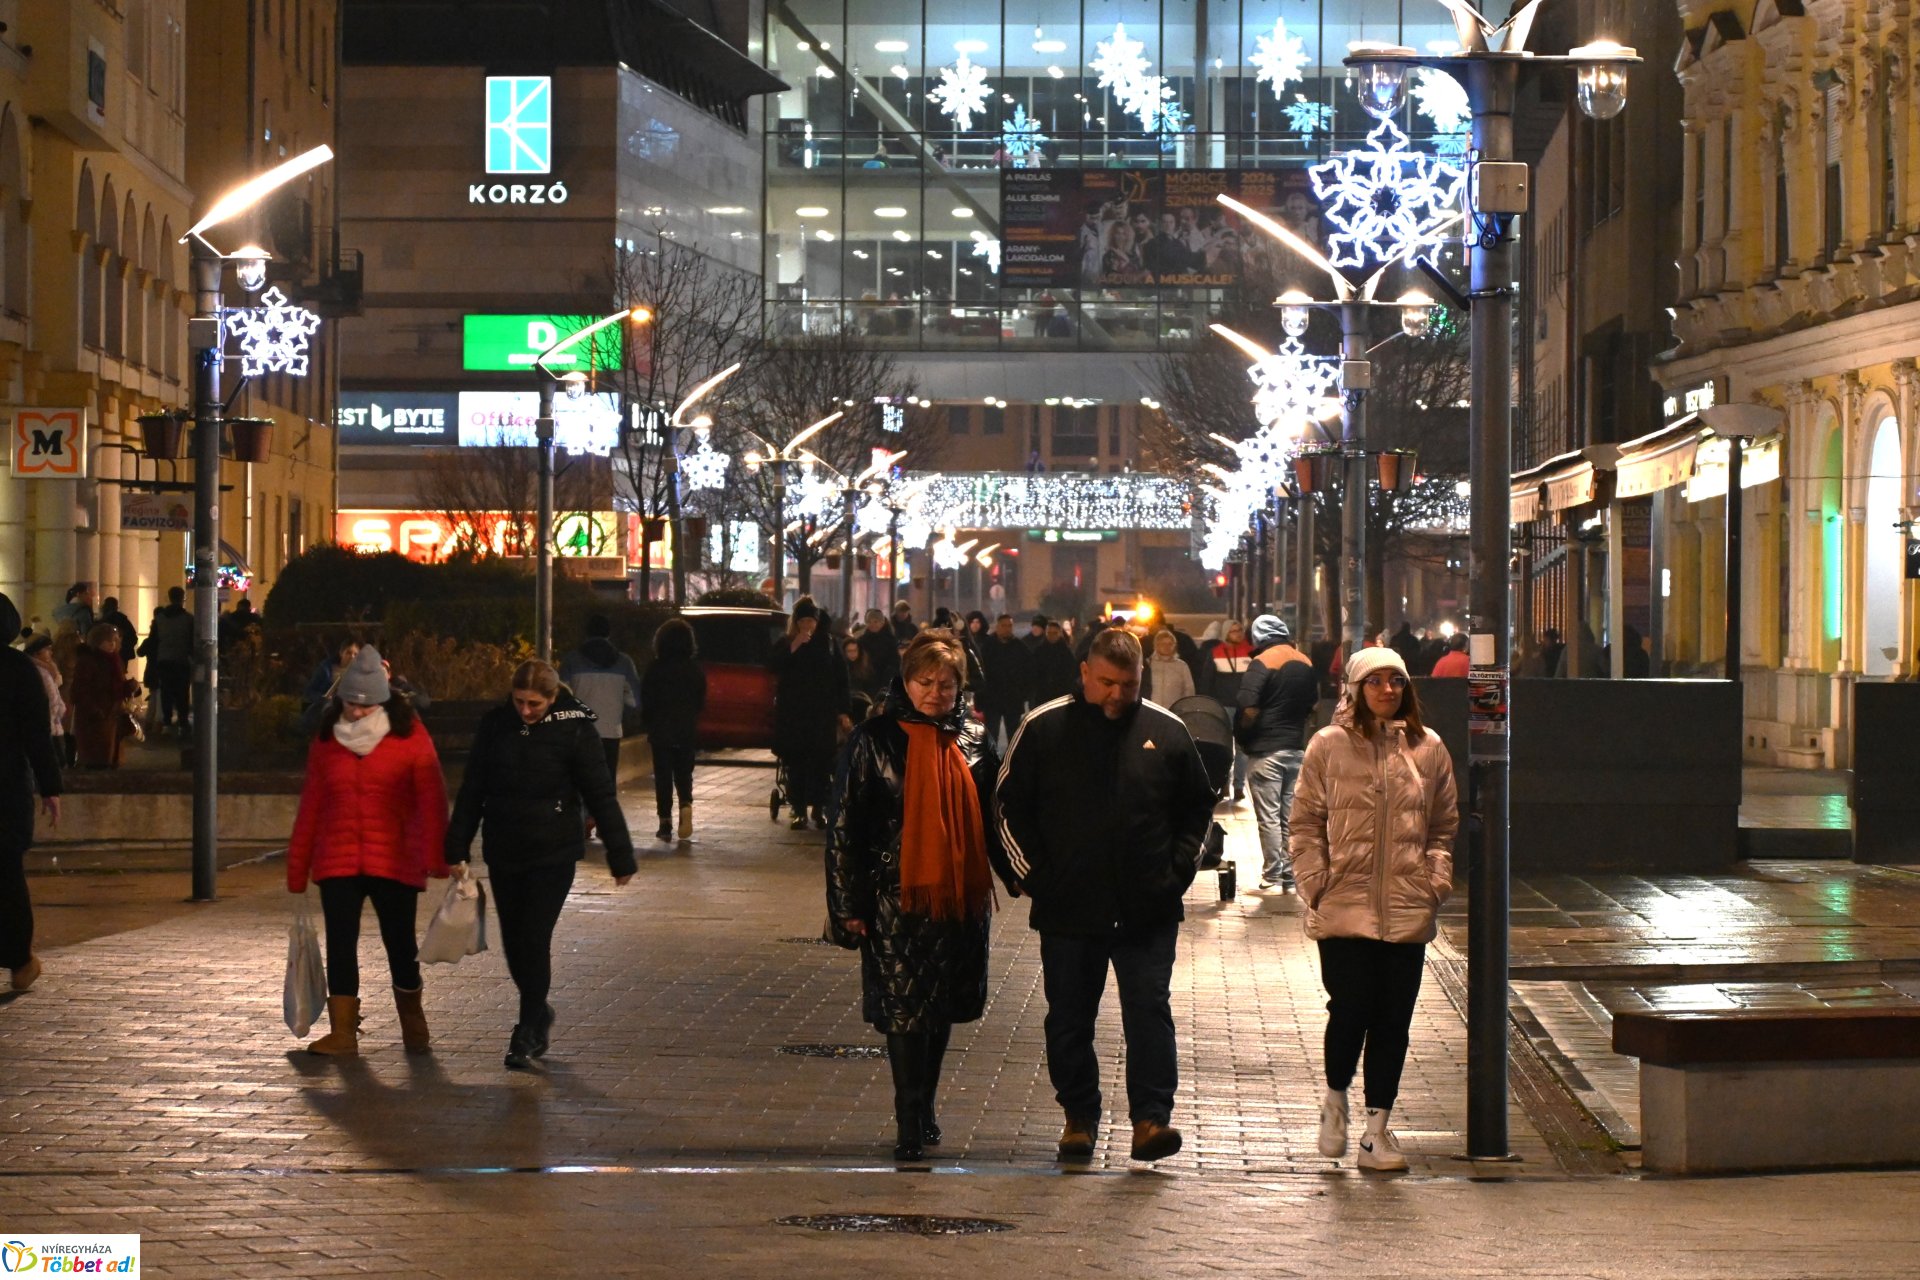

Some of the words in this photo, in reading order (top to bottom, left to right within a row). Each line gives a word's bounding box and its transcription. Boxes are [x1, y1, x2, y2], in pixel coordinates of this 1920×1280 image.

[469, 181, 567, 204] KORZÓ
[393, 408, 445, 427] BYTE
[471, 411, 537, 426] Office
[32, 429, 63, 455] M
[353, 519, 536, 555] SPAR
[553, 710, 586, 721] MARVEL
